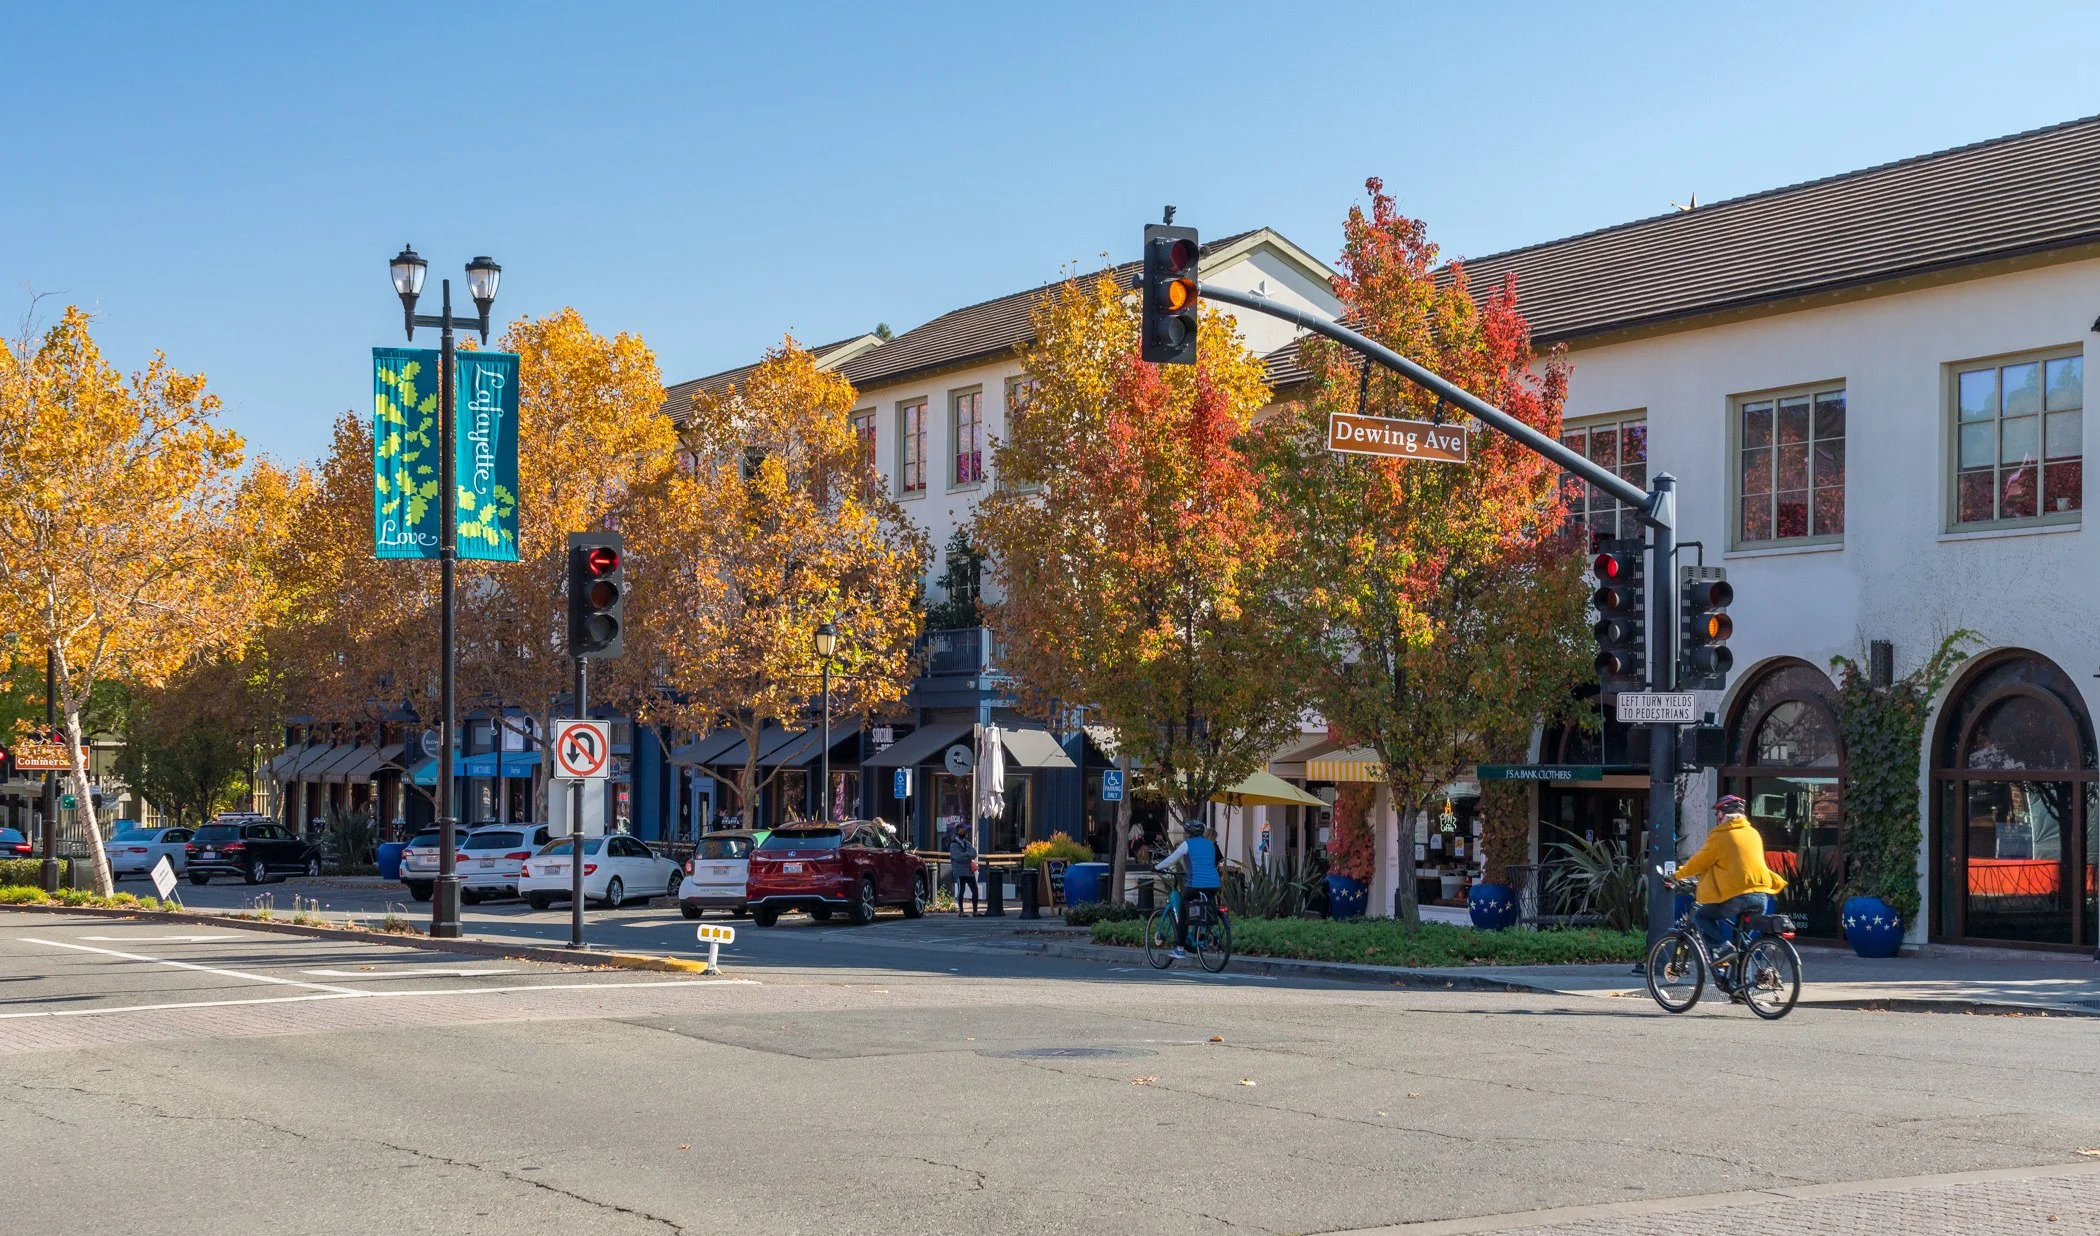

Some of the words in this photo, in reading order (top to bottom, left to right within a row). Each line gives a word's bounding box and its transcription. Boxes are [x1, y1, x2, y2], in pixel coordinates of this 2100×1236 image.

[467, 363, 505, 495] Lafayette
[1335, 421, 1418, 453] Dewing
[1424, 430, 1461, 451] Ave
[377, 519, 438, 546] Love
[1621, 696, 1638, 707] LEFT
[1642, 696, 1662, 707] TURN
[1665, 696, 1692, 707] YIELDS
[1624, 708, 1633, 719] TO
[1636, 708, 1689, 719] PEDESTRIANS
[872, 727, 895, 743] SOCIAL
[1538, 770, 1572, 779] CLOTHIERS
[1104, 785, 1121, 793] PARKING
